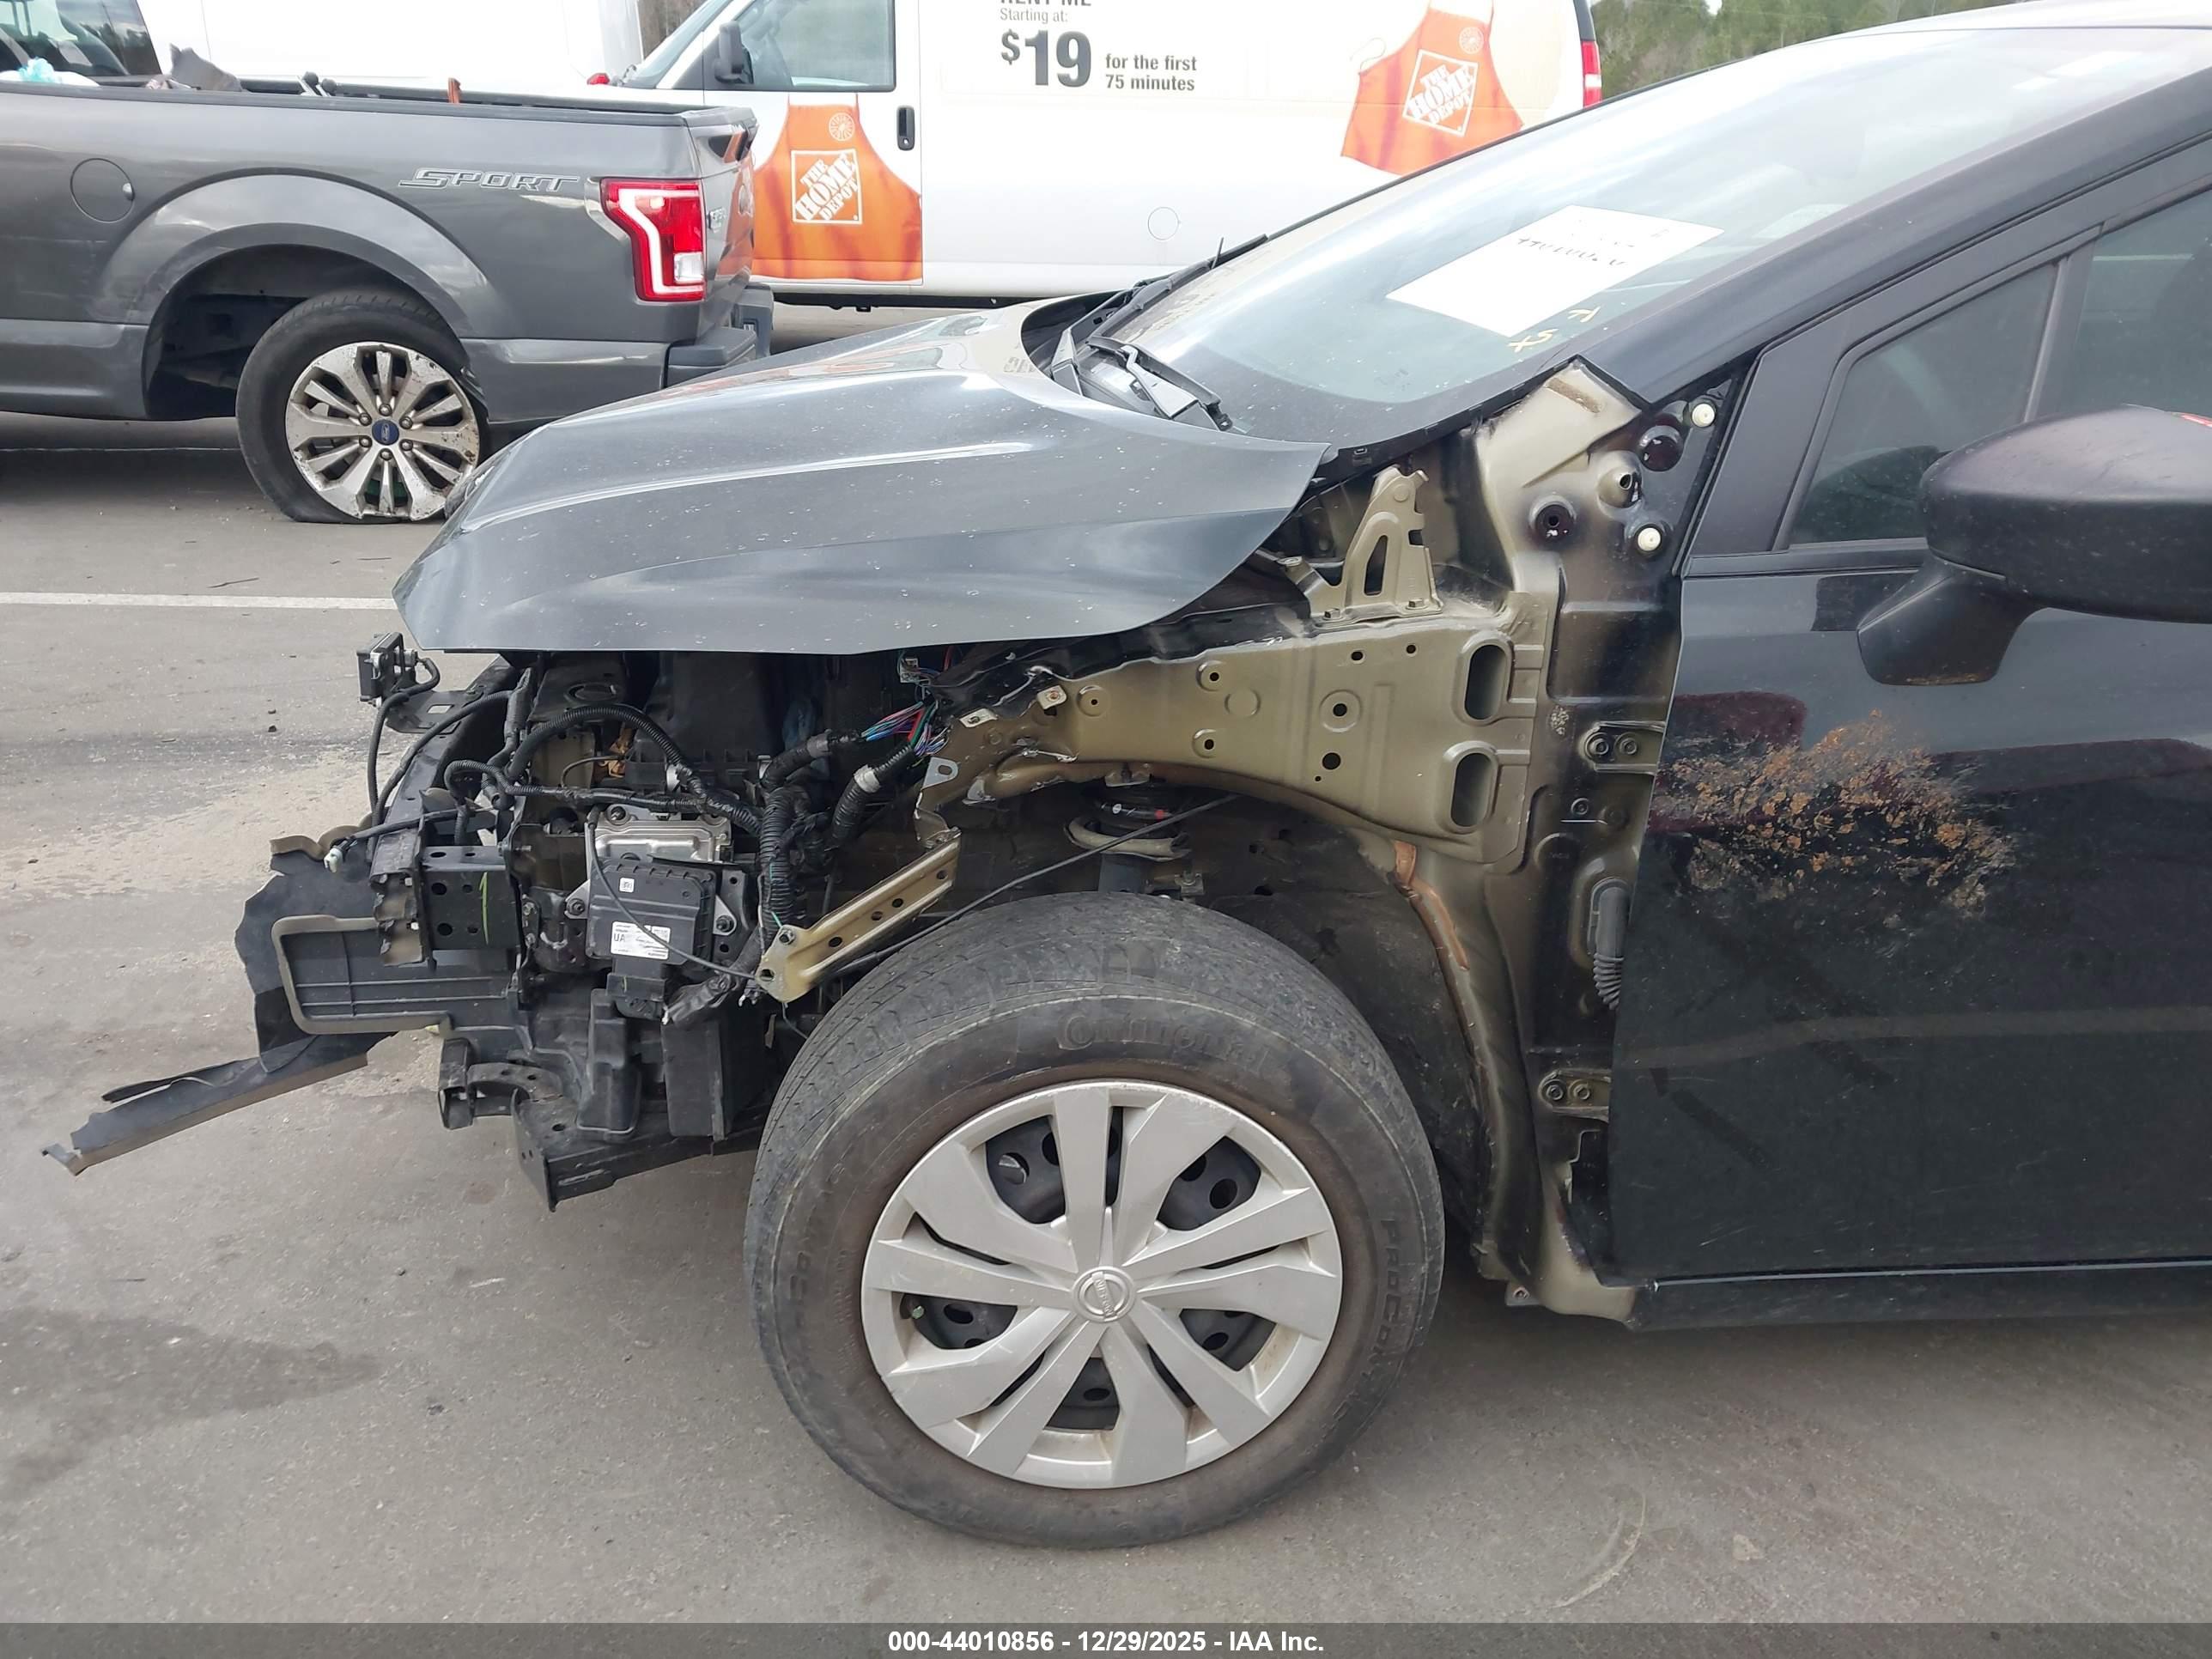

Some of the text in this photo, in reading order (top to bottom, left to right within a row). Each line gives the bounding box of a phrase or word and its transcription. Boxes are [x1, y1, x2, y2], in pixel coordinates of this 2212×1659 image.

[1000, 8, 1068, 24] Starting at:
[1000, 28, 1092, 88] $19
[1105, 53, 1197, 71] for the first
[1105, 75, 1195, 91] 75 minutes
[398, 167, 580, 193] SPORT
[795, 152, 857, 221] HOME
[799, 160, 829, 187] THE
[818, 176, 859, 221] DEPOT
